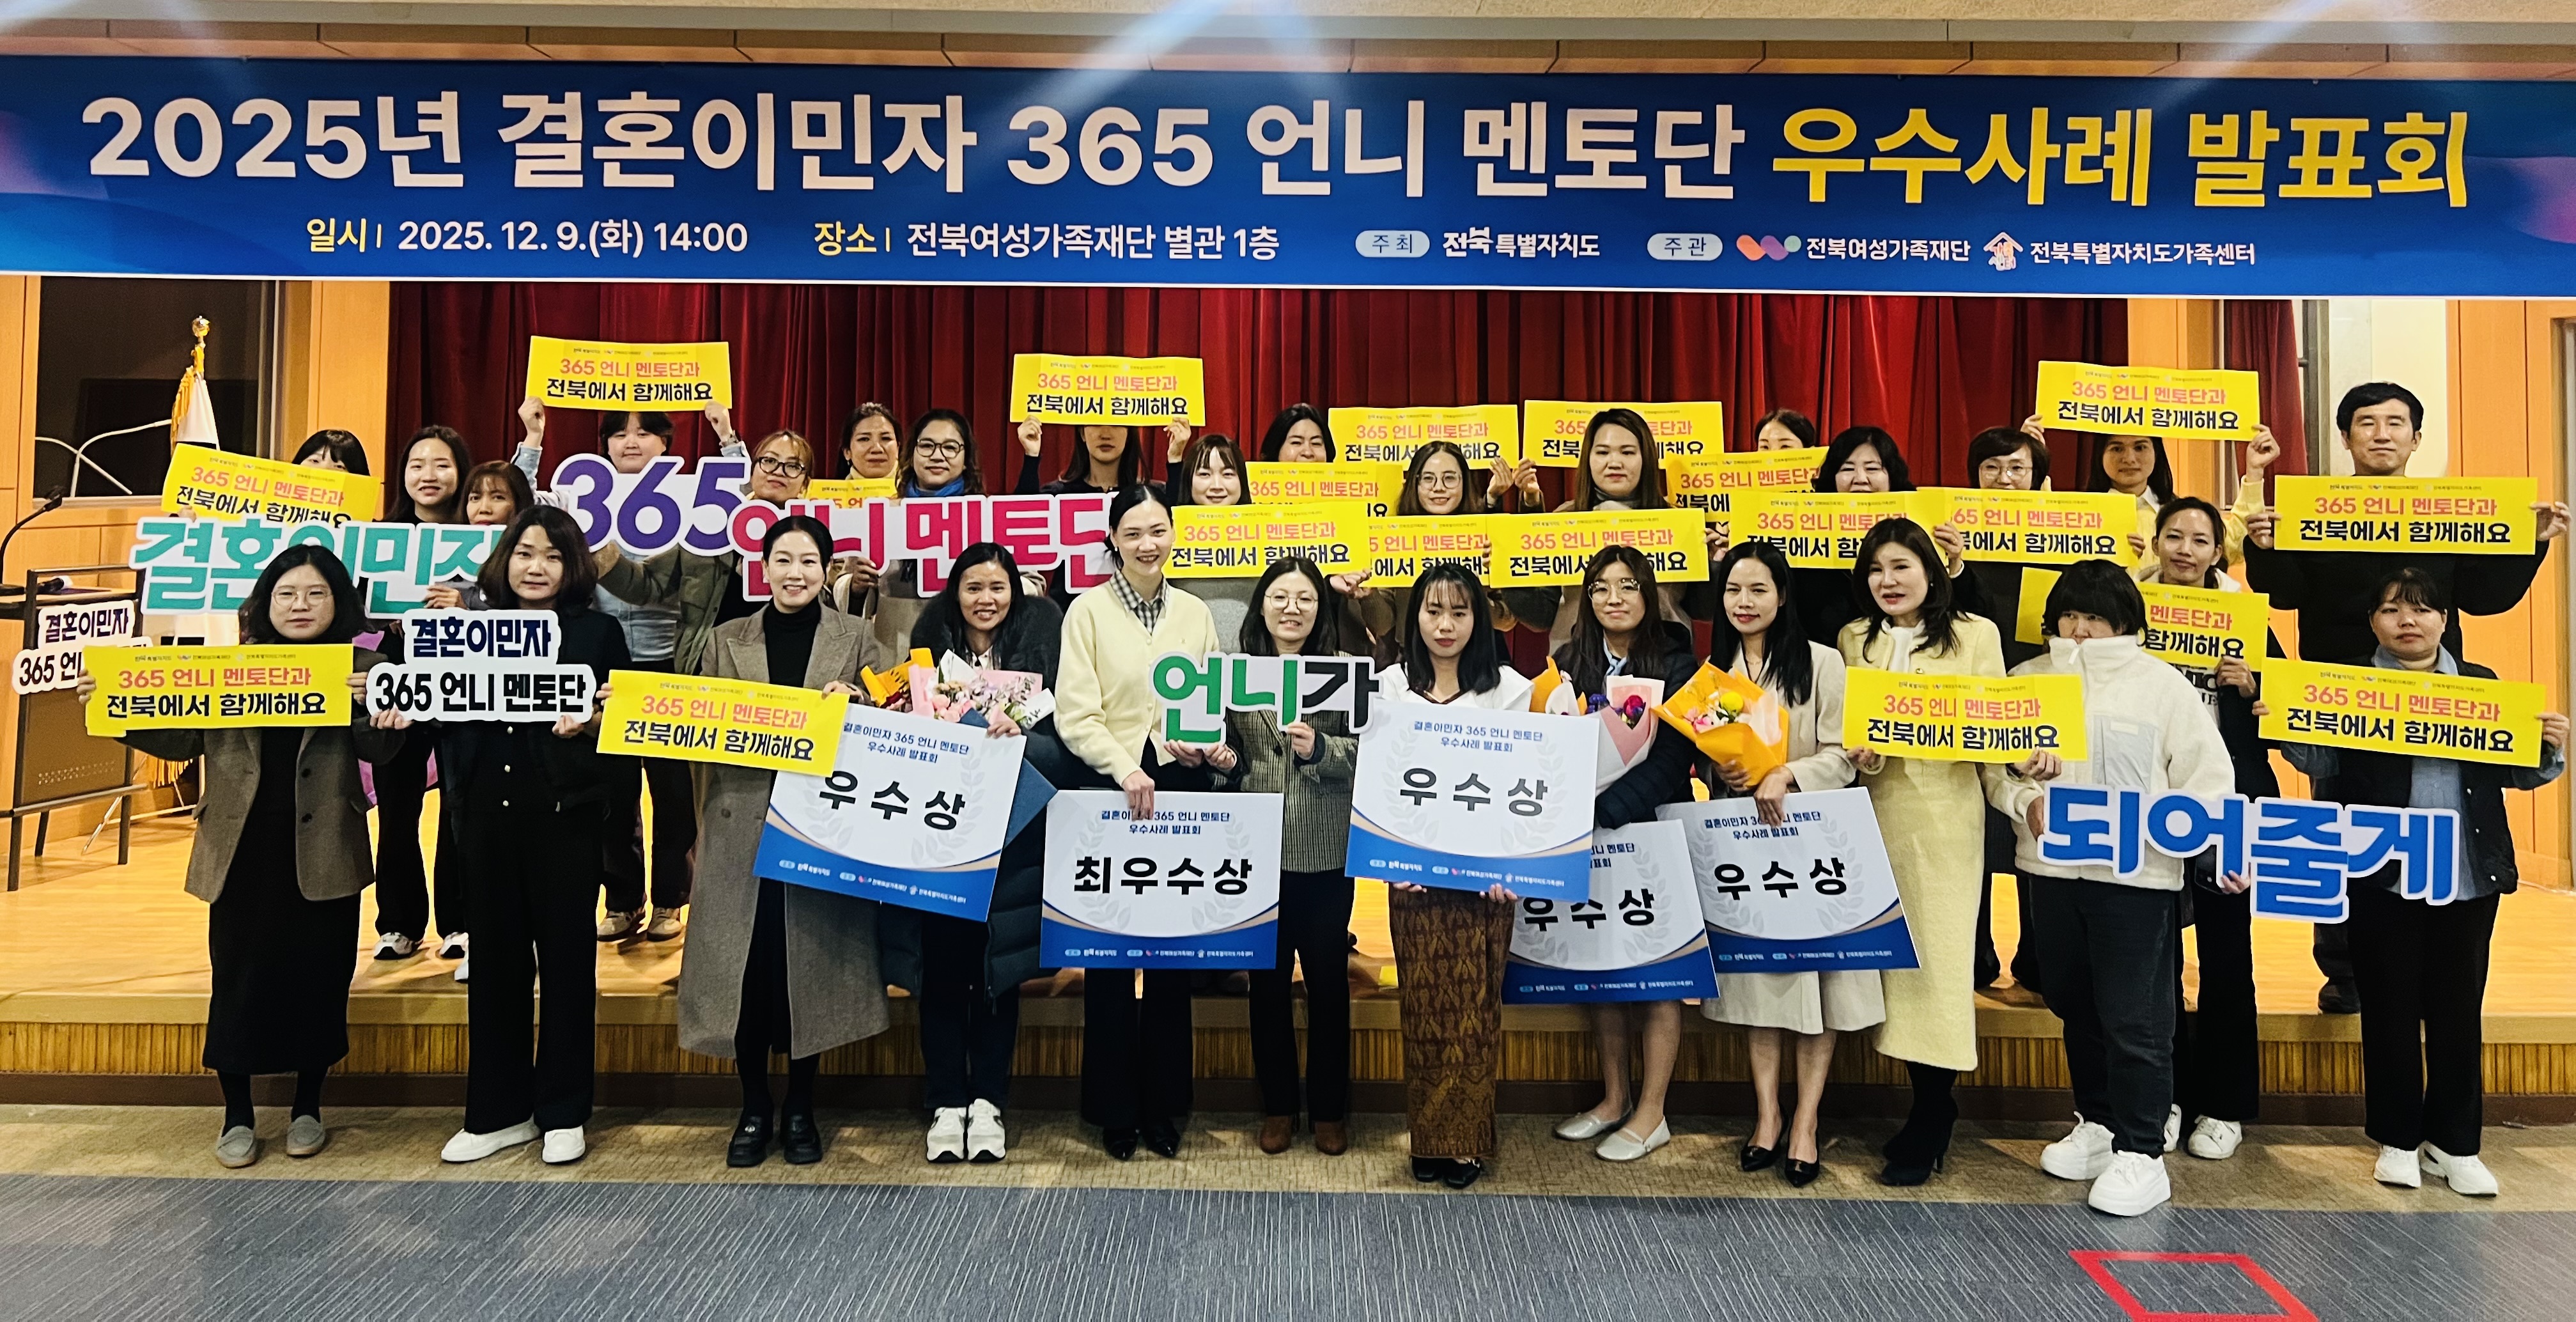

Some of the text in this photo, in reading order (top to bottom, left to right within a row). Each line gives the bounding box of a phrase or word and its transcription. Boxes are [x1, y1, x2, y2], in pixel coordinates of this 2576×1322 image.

[82, 90, 2469, 208] 2025년 결혼이민자 365 언니 멘토단 우수사례 발표회
[306, 218, 748, 258] 일시 2025. 12. 9.(화) 14:00
[814, 222, 1279, 260] 장소 전북여성가족재단 별관 1층
[1806, 237, 1970, 261] 전북여성가족재단
[2030, 241, 2255, 265] 전북특별자치도가족센터
[560, 358, 699, 377] 365 언니 멘토단과
[547, 378, 713, 401] 전북에서 함께해요
[1038, 373, 1177, 391] 365 언니 멘토단과
[2072, 381, 2226, 405] 365 언니 멘토단과
[1027, 394, 1188, 415] 전북에서 함께해요
[2058, 401, 2238, 430] 전북에서 함께해요
[1356, 422, 1488, 439] 365 언니 멘토단과
[1555, 419, 1586, 434] 365
[1461, 442, 1500, 459] 해요
[1542, 440, 1580, 458] 전북
[191, 467, 229, 487] 365
[235, 474, 268, 494] 언니
[274, 481, 345, 506] 멘토단과
[1250, 481, 1379, 497] 365 언니 멘토단과
[1680, 473, 1714, 489] 365
[1719, 471, 1751, 487] 언니
[176, 485, 259, 514] 전북에서
[557, 459, 745, 550] 365
[1676, 494, 1729, 511] 전북에
[2315, 497, 2497, 516] 365 언니 멘토단과
[1758, 513, 1794, 529] 365
[1800, 513, 1832, 531] 언니
[1950, 509, 2102, 529] 65 언니 멘토단과
[2301, 519, 2510, 543] 전북에서 함께해요
[1184, 522, 1335, 541] 365 언니 멘토단과
[1385, 535, 1416, 552] 언니
[1521, 529, 1673, 550] 365 언니 멘토단과
[2025, 533, 2116, 555] 함께해요
[1172, 547, 1256, 567] 전북에서
[1372, 557, 1413, 577] 에서
[1647, 552, 1688, 572] 해요
[45, 608, 128, 643] 결혼이민자
[2150, 605, 2232, 631] 멘토단과
[412, 616, 551, 657] 결혼이민자
[2145, 628, 2244, 658] 함께해요
[20, 655, 54, 686] 365
[118, 667, 311, 688] 365 언니 멘토단과
[376, 673, 586, 713] 365 언니 멘토단
[1154, 656, 1379, 742] 언니가
[2304, 684, 2500, 722] 365 언니 멘토단과
[107, 693, 325, 718] 전북에서 함께해요
[642, 695, 807, 730] 365 언니 멘토단과
[1884, 694, 2041, 720] 365 언니 멘토단과
[625, 720, 814, 761] 전북에서 함께해요
[844, 721, 969, 756] 결혼이민자 365 언니 멘토단
[1415, 721, 1542, 741] 결혼이민자 365 언니 멘토단
[1868, 719, 2060, 750] 전북에서 함께해요
[2287, 708, 2513, 752] 전북에서 함께해요
[867, 742, 938, 763] 우수사례 발표회
[1441, 737, 1513, 752] 우수사례 발표회
[819, 770, 965, 830] 우수상
[1400, 768, 1548, 816] 우수상
[1155, 811, 1174, 821] 365
[1178, 811, 1197, 821] 언니
[1201, 812, 1229, 821] 멘토단
[1705, 817, 1748, 828] 결혼이민자
[1129, 825, 1200, 835] 우수사례 발표회
[1734, 828, 1769, 840] 우수사례
[1590, 858, 1611, 868] 표회
[2044, 786, 2453, 917] 되어줄게
[1075, 857, 1252, 895] 최우수상
[1715, 857, 1847, 900] 우수상
